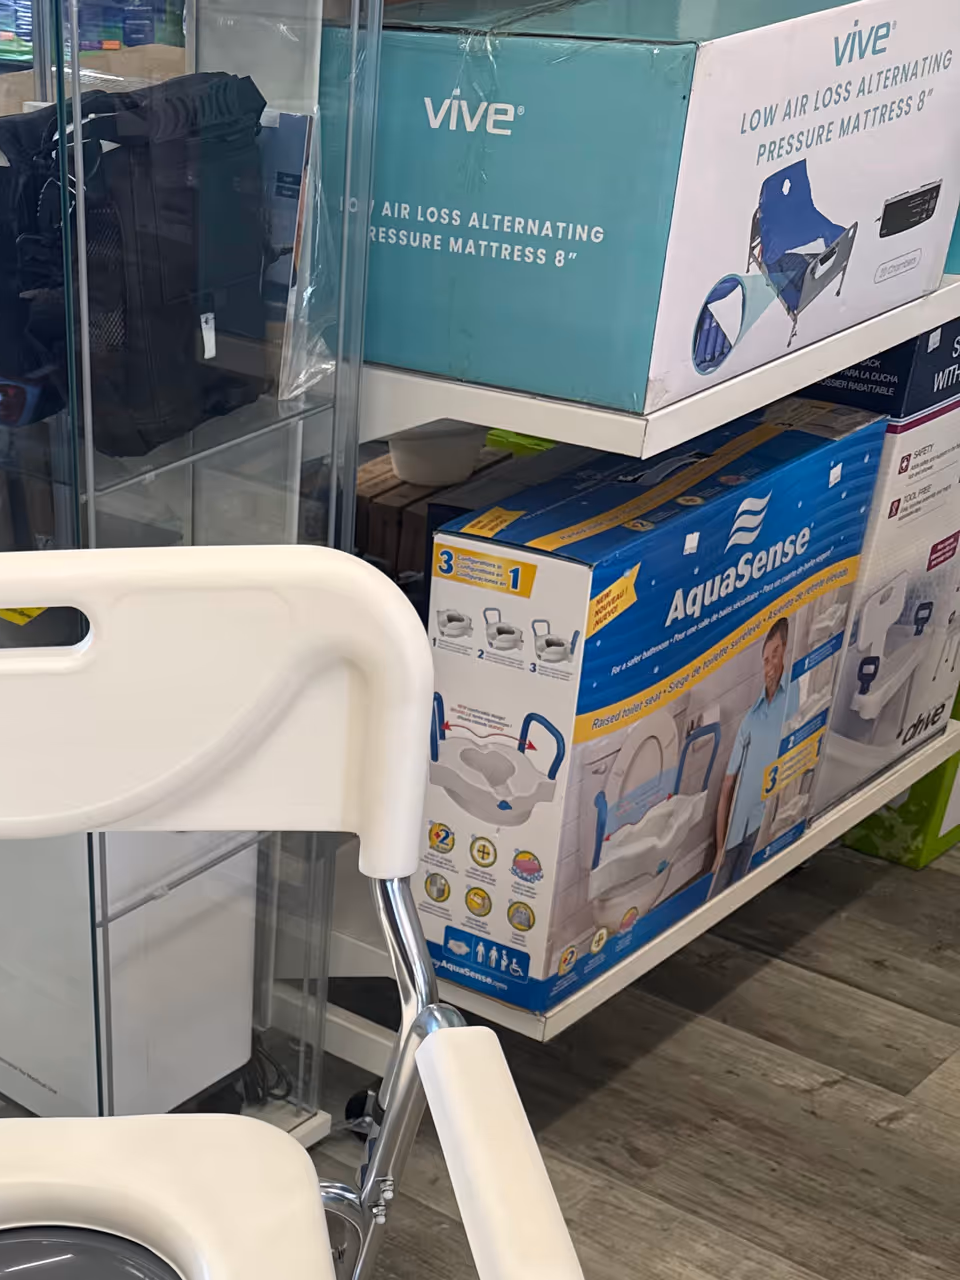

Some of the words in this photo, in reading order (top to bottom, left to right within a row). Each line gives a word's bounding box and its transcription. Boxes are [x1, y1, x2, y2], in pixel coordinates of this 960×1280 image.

[740, 103, 779, 135] LOW
[782, 94, 809, 121] AIR
[813, 80, 852, 112] LOSS
[856, 49, 953, 98] ALTERNATING
[756, 121, 834, 166] PRESSURE
[838, 95, 913, 139] MATTRESS
[381, 200, 410, 220] AIR
[417, 206, 461, 226] LOSS
[468, 212, 605, 243] ALTERNATING
[449, 237, 547, 265] MATTRESS
[848, 380, 895, 396] RABATTABLE
[871, 371, 898, 384] DUCHA
[913, 442, 935, 460] SAFETY
[438, 549, 454, 575] 3
[509, 566, 521, 591] 1
[664, 525, 811, 628] AquaSense
[477, 649, 484, 660] 2
[529, 663, 537, 673] 3
[610, 664, 622, 676] For
[591, 709, 621, 731] Raised
[621, 701, 643, 719] toilet
[902, 702, 946, 746] drive
[764, 765, 779, 793] 3
